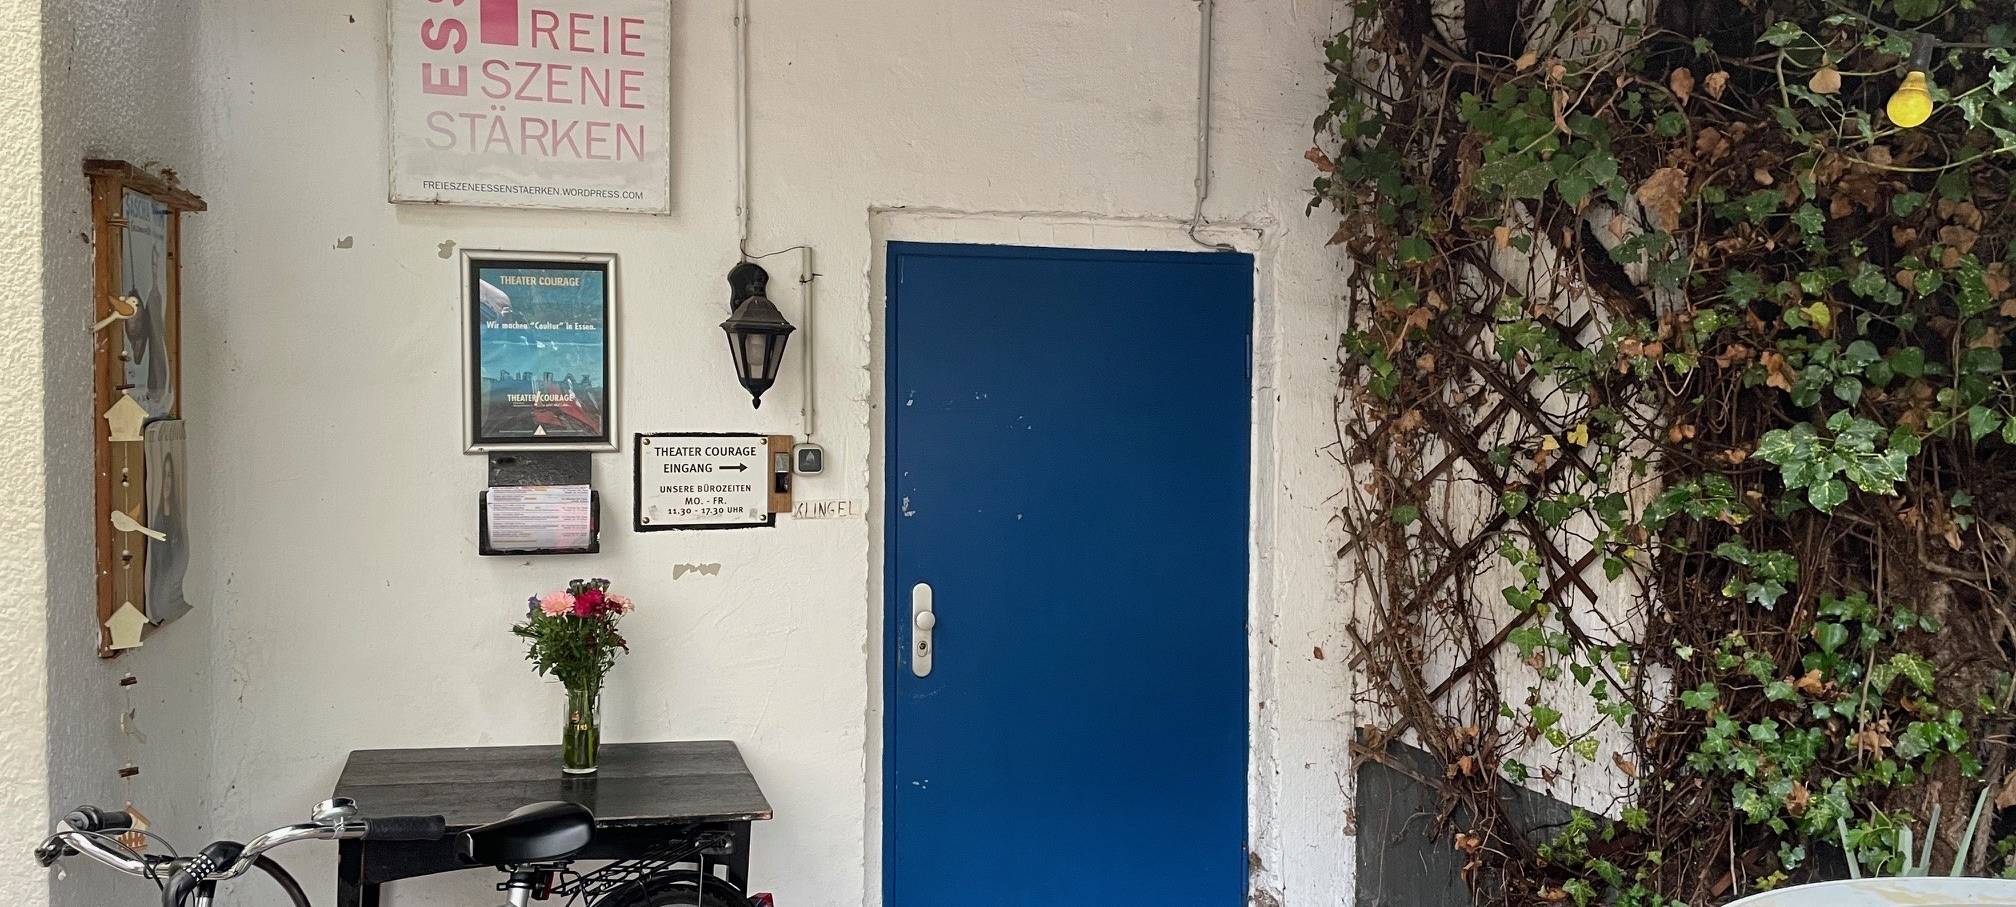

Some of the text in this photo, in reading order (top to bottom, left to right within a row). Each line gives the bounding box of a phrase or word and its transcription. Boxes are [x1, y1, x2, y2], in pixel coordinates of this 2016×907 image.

[421, 0, 468, 97] ES
[480, 59, 646, 109] SZENE
[424, 104, 645, 162] STÄRKEN
[423, 180, 644, 200] FREIESZENEESSENSTAERKEN.WORDPRESS.COM
[500, 275, 580, 287] THEATER COURAGE
[486, 320, 500, 330] Wir
[502, 321, 528, 331] machen
[574, 323, 597, 332] Essen.
[507, 393, 574, 402] THEATER COURAGE
[654, 446, 757, 457] THEATER COURAGE
[663, 463, 713, 473] EINGANG
[660, 483, 752, 493] UNSERE BÜROZEITEN
[685, 497, 704, 505] MO.
[713, 496, 727, 505] FR.
[668, 508, 692, 516] 11.30
[701, 507, 724, 515] 17.30
[727, 506, 744, 514] UHR
[793, 501, 860, 519] KLINGEL
